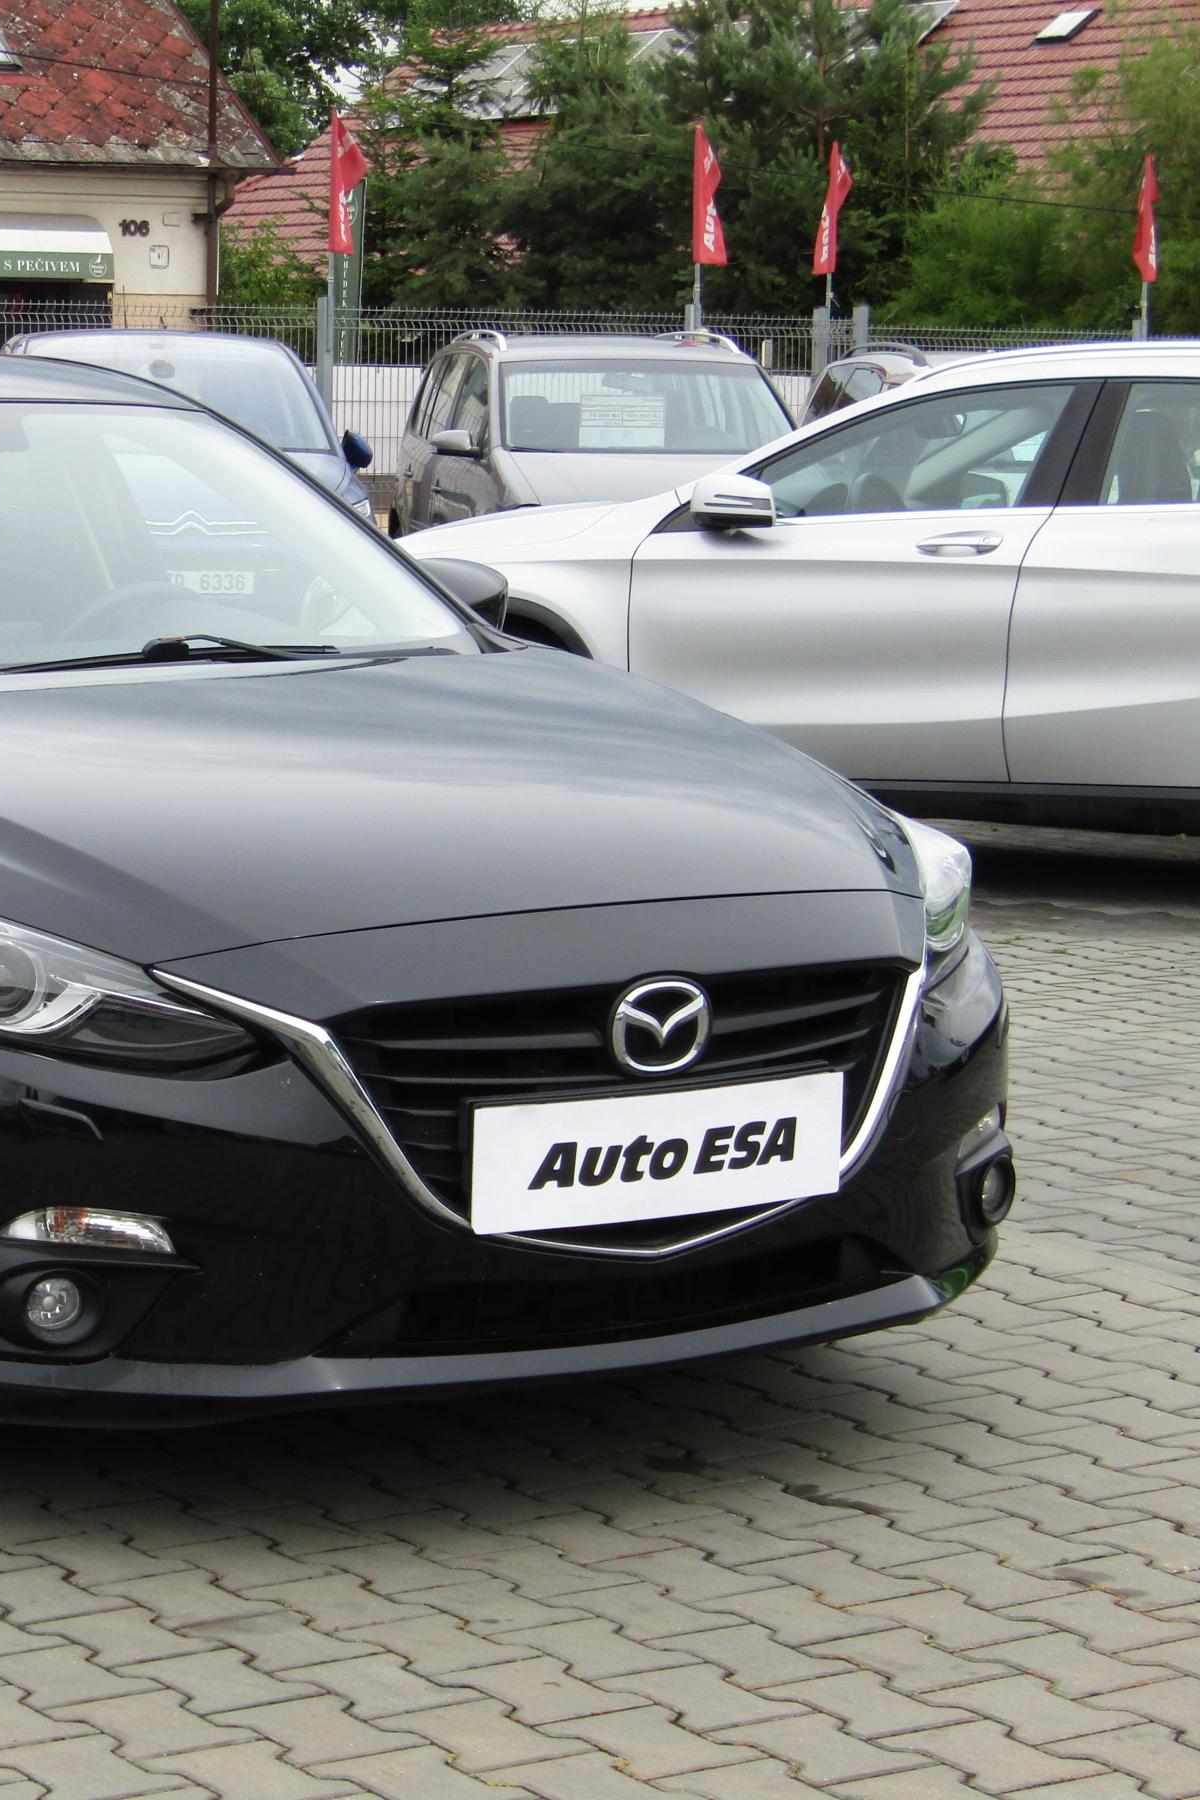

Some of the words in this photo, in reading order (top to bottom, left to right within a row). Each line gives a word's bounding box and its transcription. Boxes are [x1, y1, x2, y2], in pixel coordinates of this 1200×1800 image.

[118, 219, 150, 237] 106
[3, 259, 12, 271] S
[17, 258, 80, 273] PEČIVEM
[200, 574, 245, 591] 6336
[527, 1135, 689, 1190] Auto
[693, 1116, 797, 1175] ESA
